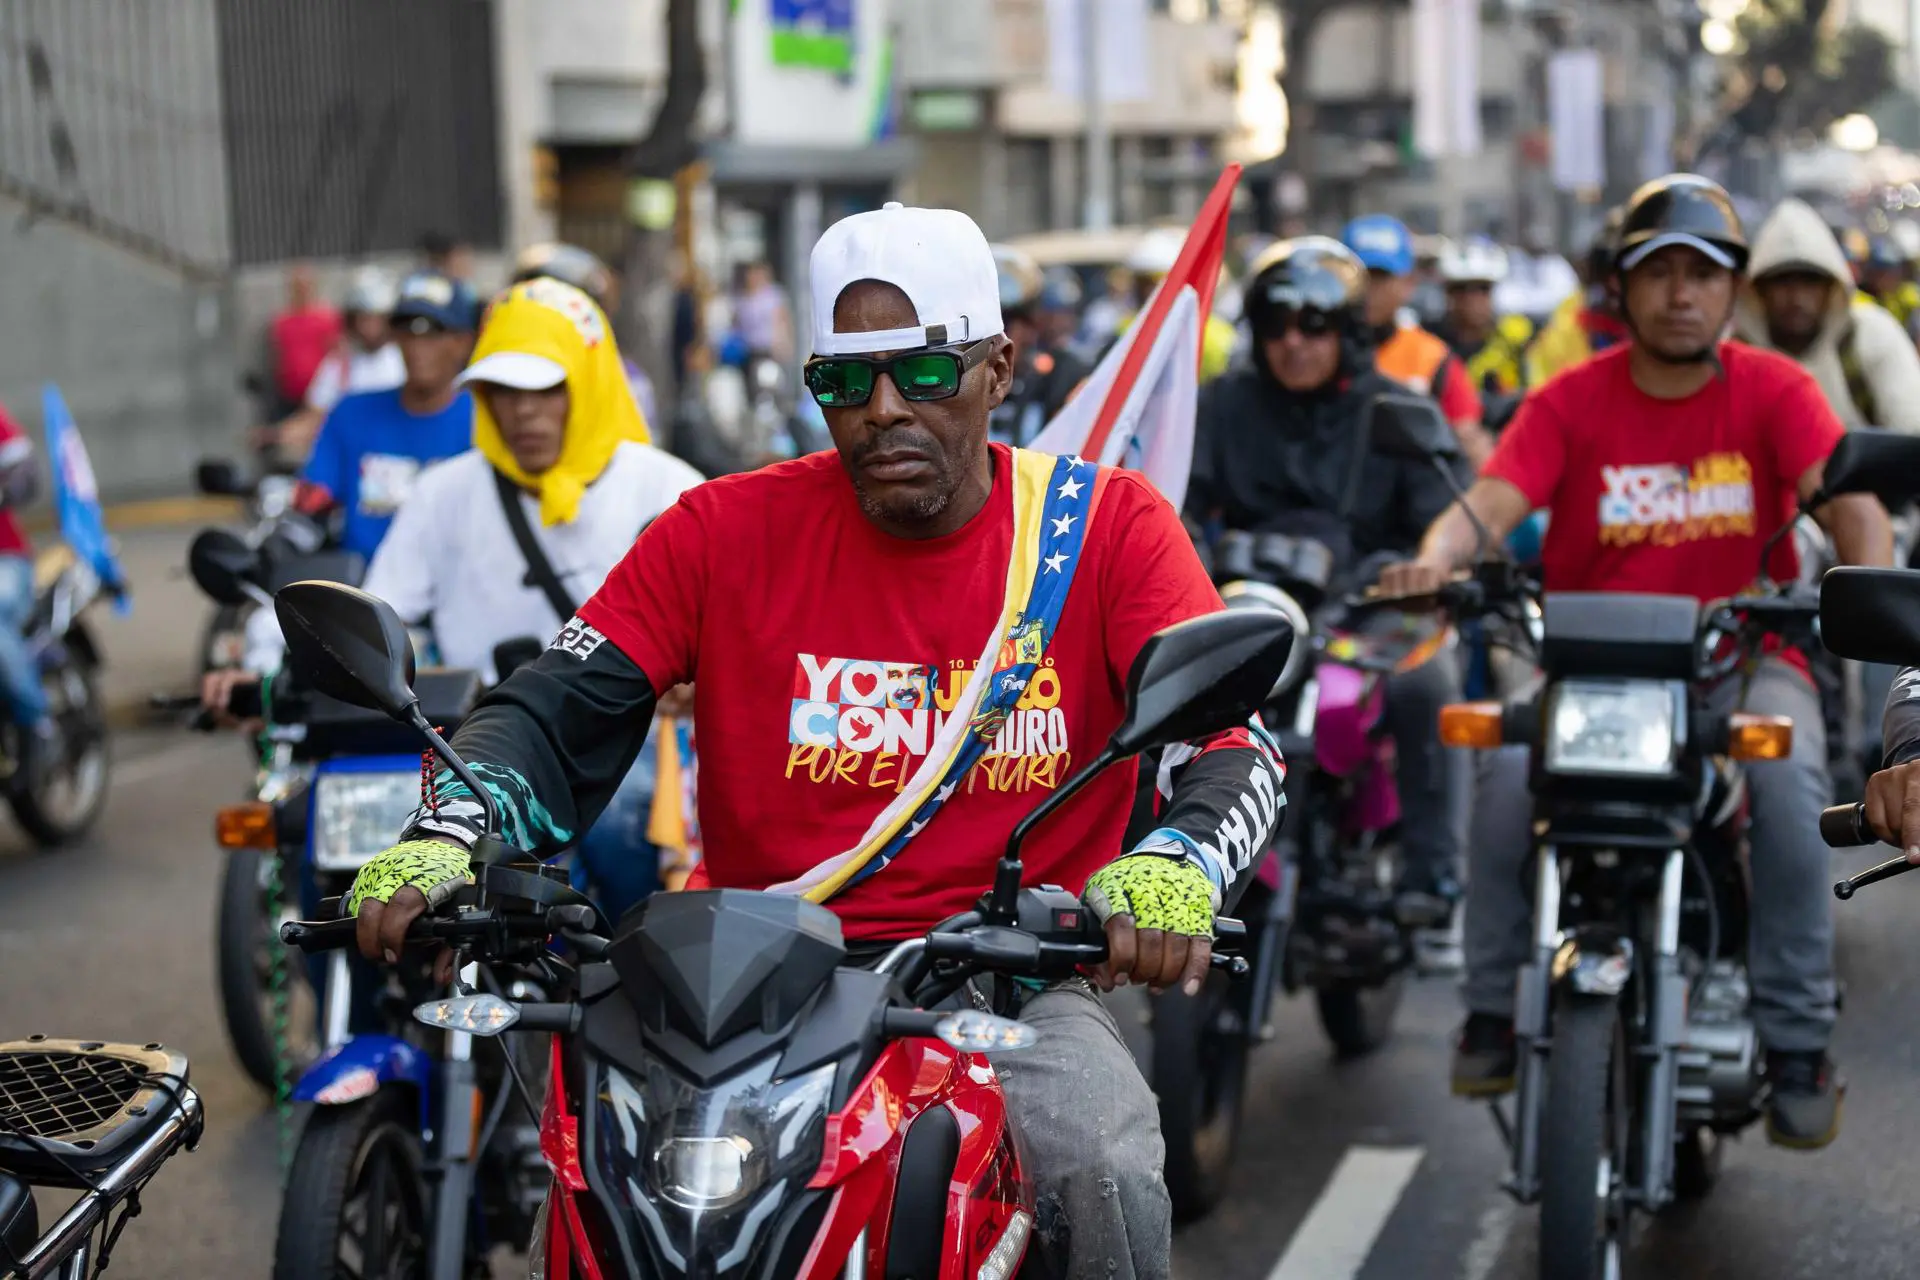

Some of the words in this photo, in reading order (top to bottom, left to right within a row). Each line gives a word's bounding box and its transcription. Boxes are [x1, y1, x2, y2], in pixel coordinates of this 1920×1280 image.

[797, 653, 886, 707] YO
[949, 659, 965, 669] 10
[935, 667, 1061, 712] JO
[791, 702, 928, 755] CON
[785, 744, 860, 785] POR
[868, 752, 910, 793] EL
